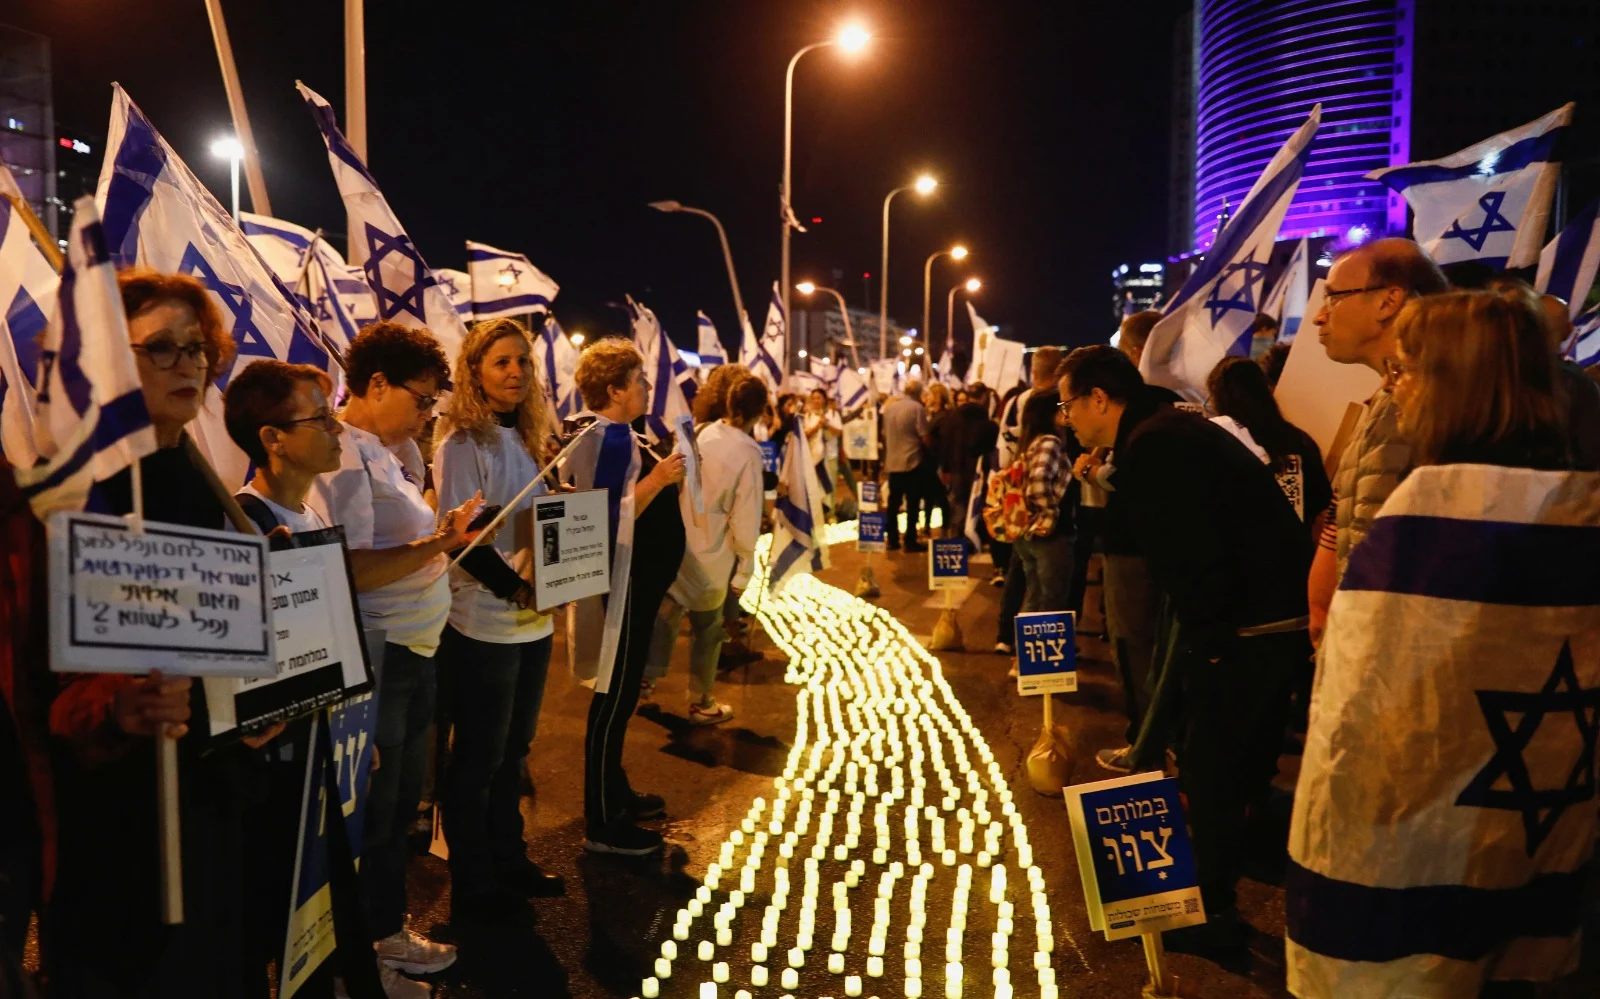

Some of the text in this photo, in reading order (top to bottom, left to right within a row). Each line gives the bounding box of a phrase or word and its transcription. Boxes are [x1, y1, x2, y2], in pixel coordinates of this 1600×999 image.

[163, 535, 204, 558] לחם
[213, 546, 251, 564] אחי
[192, 561, 257, 586] ישראל
[197, 590, 240, 611] האם
[293, 587, 319, 609] אמנון
[190, 609, 229, 639] נפל
[289, 646, 329, 670] במלחמת
